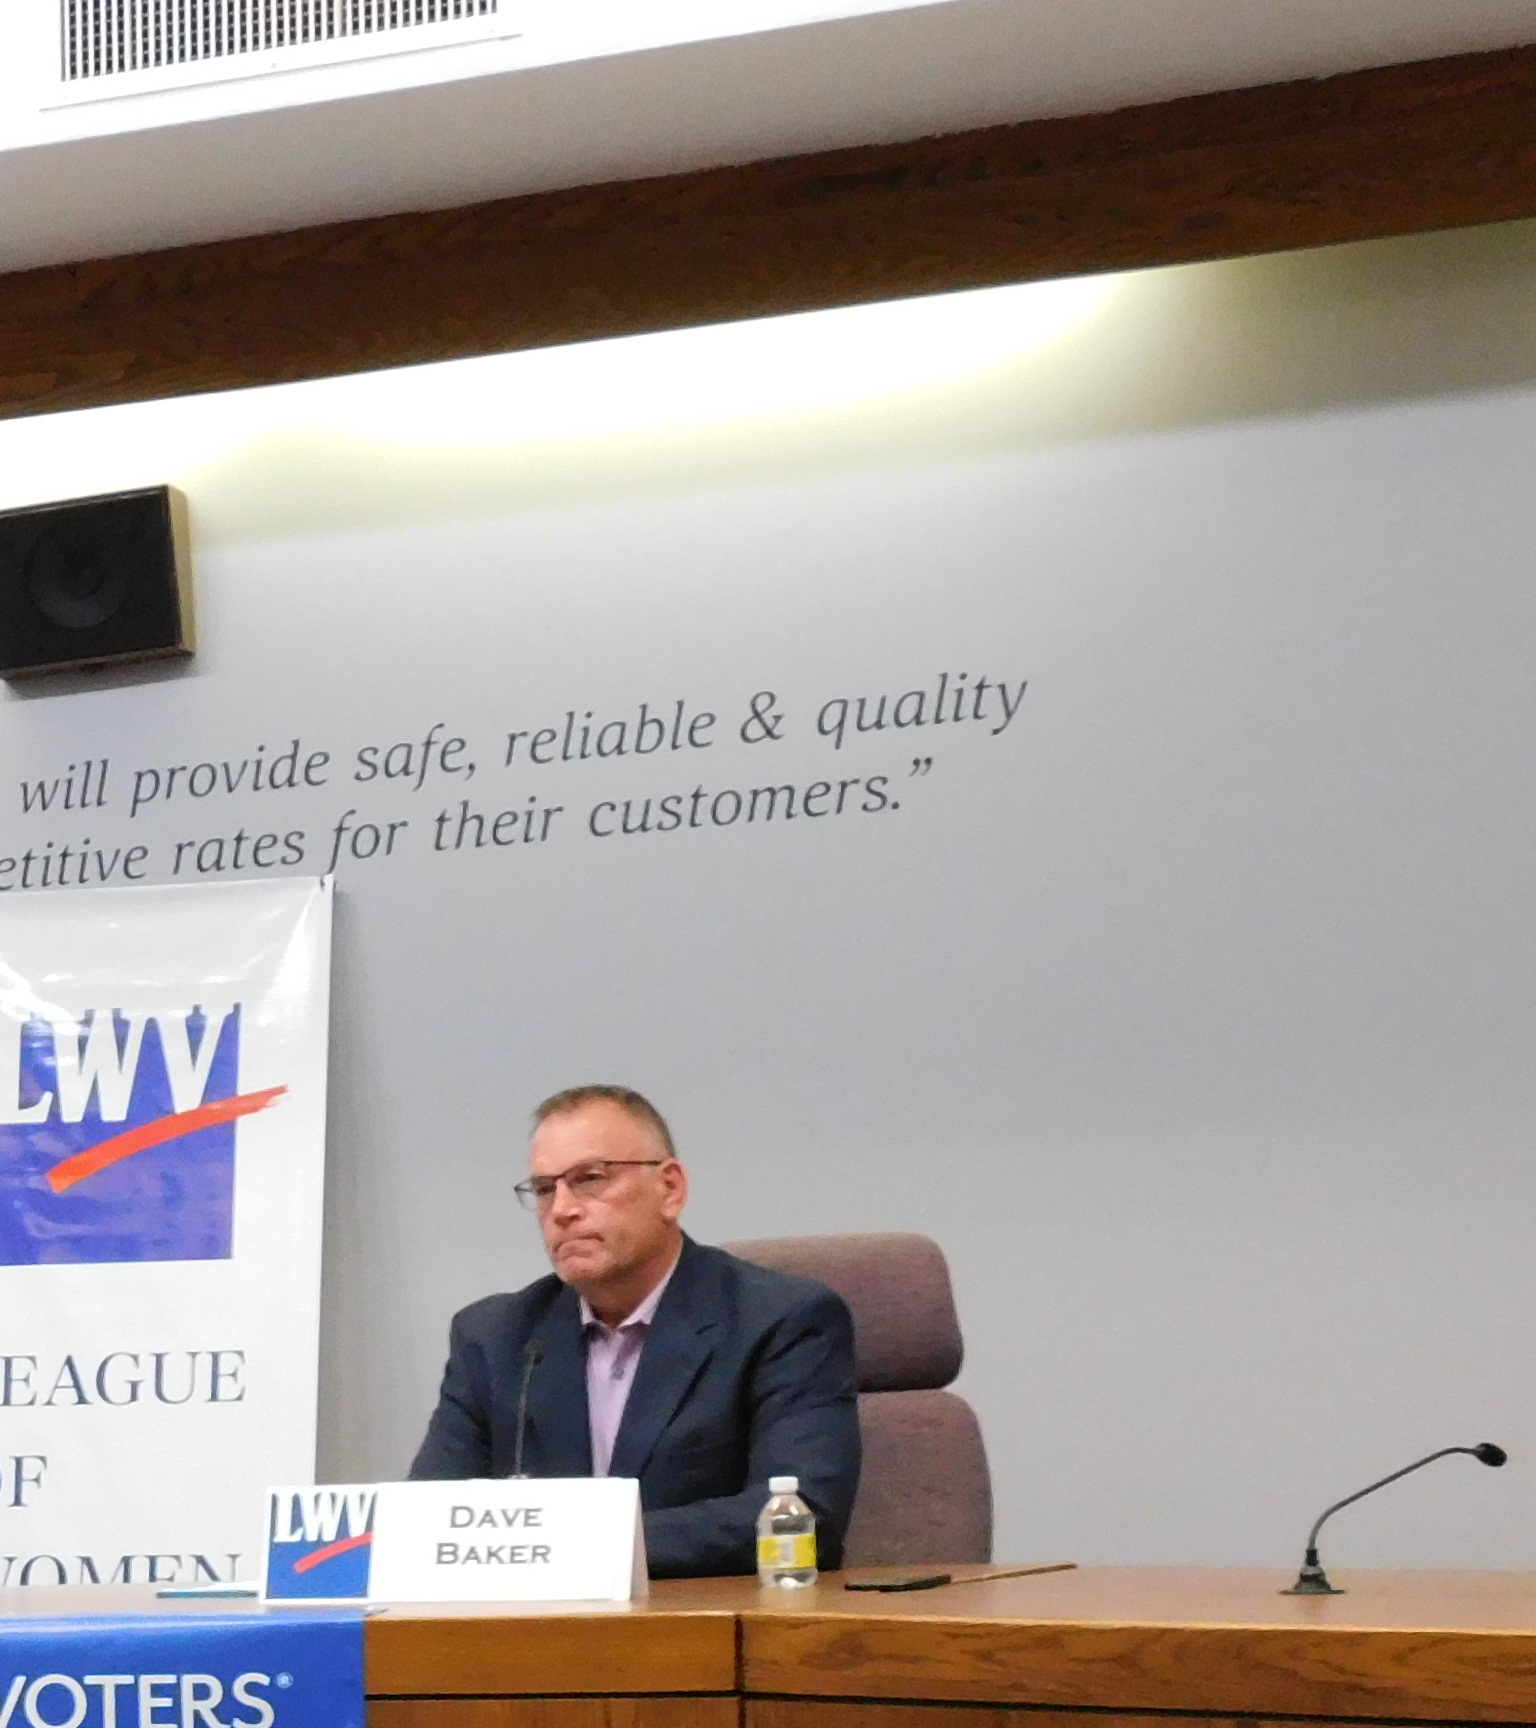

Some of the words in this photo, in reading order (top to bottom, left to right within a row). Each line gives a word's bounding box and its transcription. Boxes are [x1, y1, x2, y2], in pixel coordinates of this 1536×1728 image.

[20, 760, 110, 814] will
[130, 740, 330, 817] provide
[354, 722, 477, 791] safe,
[504, 699, 717, 769] reliable
[740, 690, 785, 743] &
[817, 671, 1029, 750] quality
[173, 828, 305, 875] rates
[326, 809, 408, 874] for
[434, 794, 563, 854] their
[588, 757, 933, 843] customers.”
[273, 1492, 377, 1543] LWV
[449, 1505, 544, 1530] DAVE
[435, 1542, 552, 1566] BAKER
